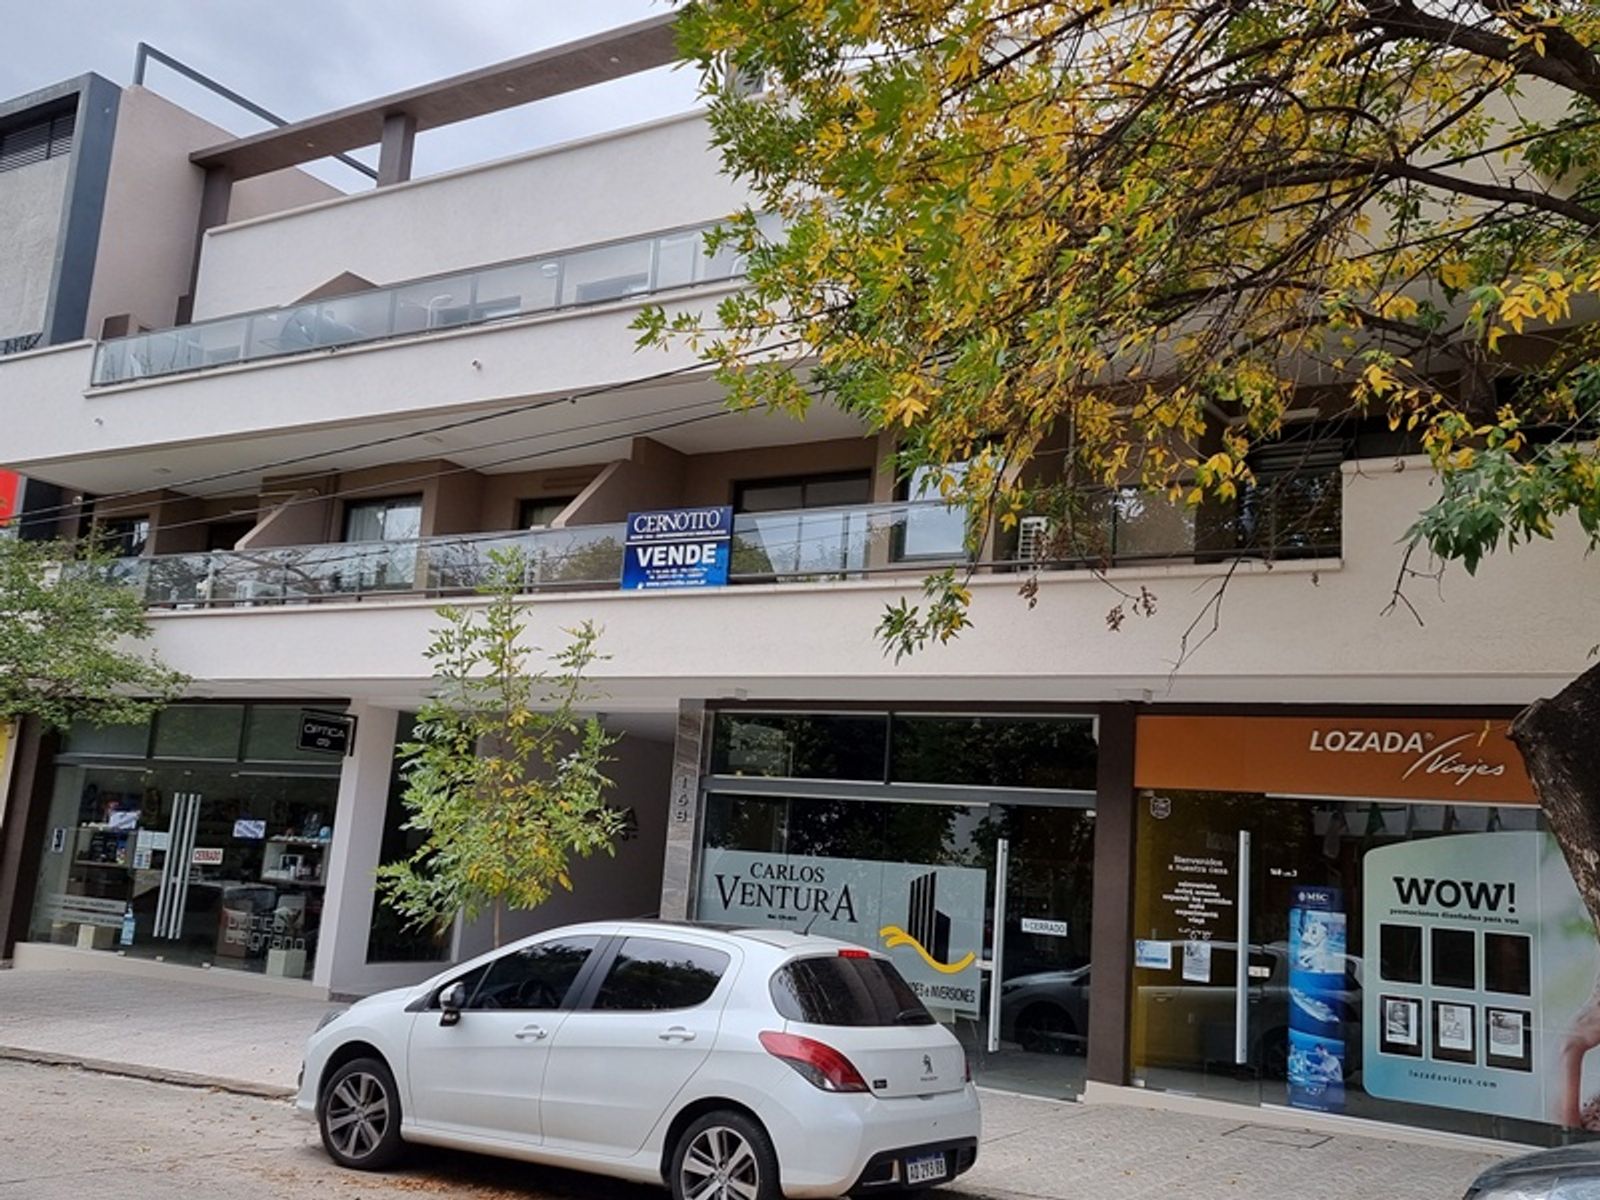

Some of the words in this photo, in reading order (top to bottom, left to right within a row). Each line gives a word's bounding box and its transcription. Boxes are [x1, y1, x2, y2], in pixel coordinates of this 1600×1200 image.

[633, 510, 720, 533] CERNOTTO
[636, 543, 717, 567] VENDE
[1309, 731, 1424, 753] LOZADA
[1426, 752, 1505, 786] Viajes
[194, 850, 221, 861] CERRADO
[750, 862, 825, 883] CARLOS
[714, 874, 858, 923] VENTURA
[1393, 876, 1515, 913] WOW!
[1031, 921, 1065, 933] CERRADO
[930, 984, 975, 1004] INVERSIONES
